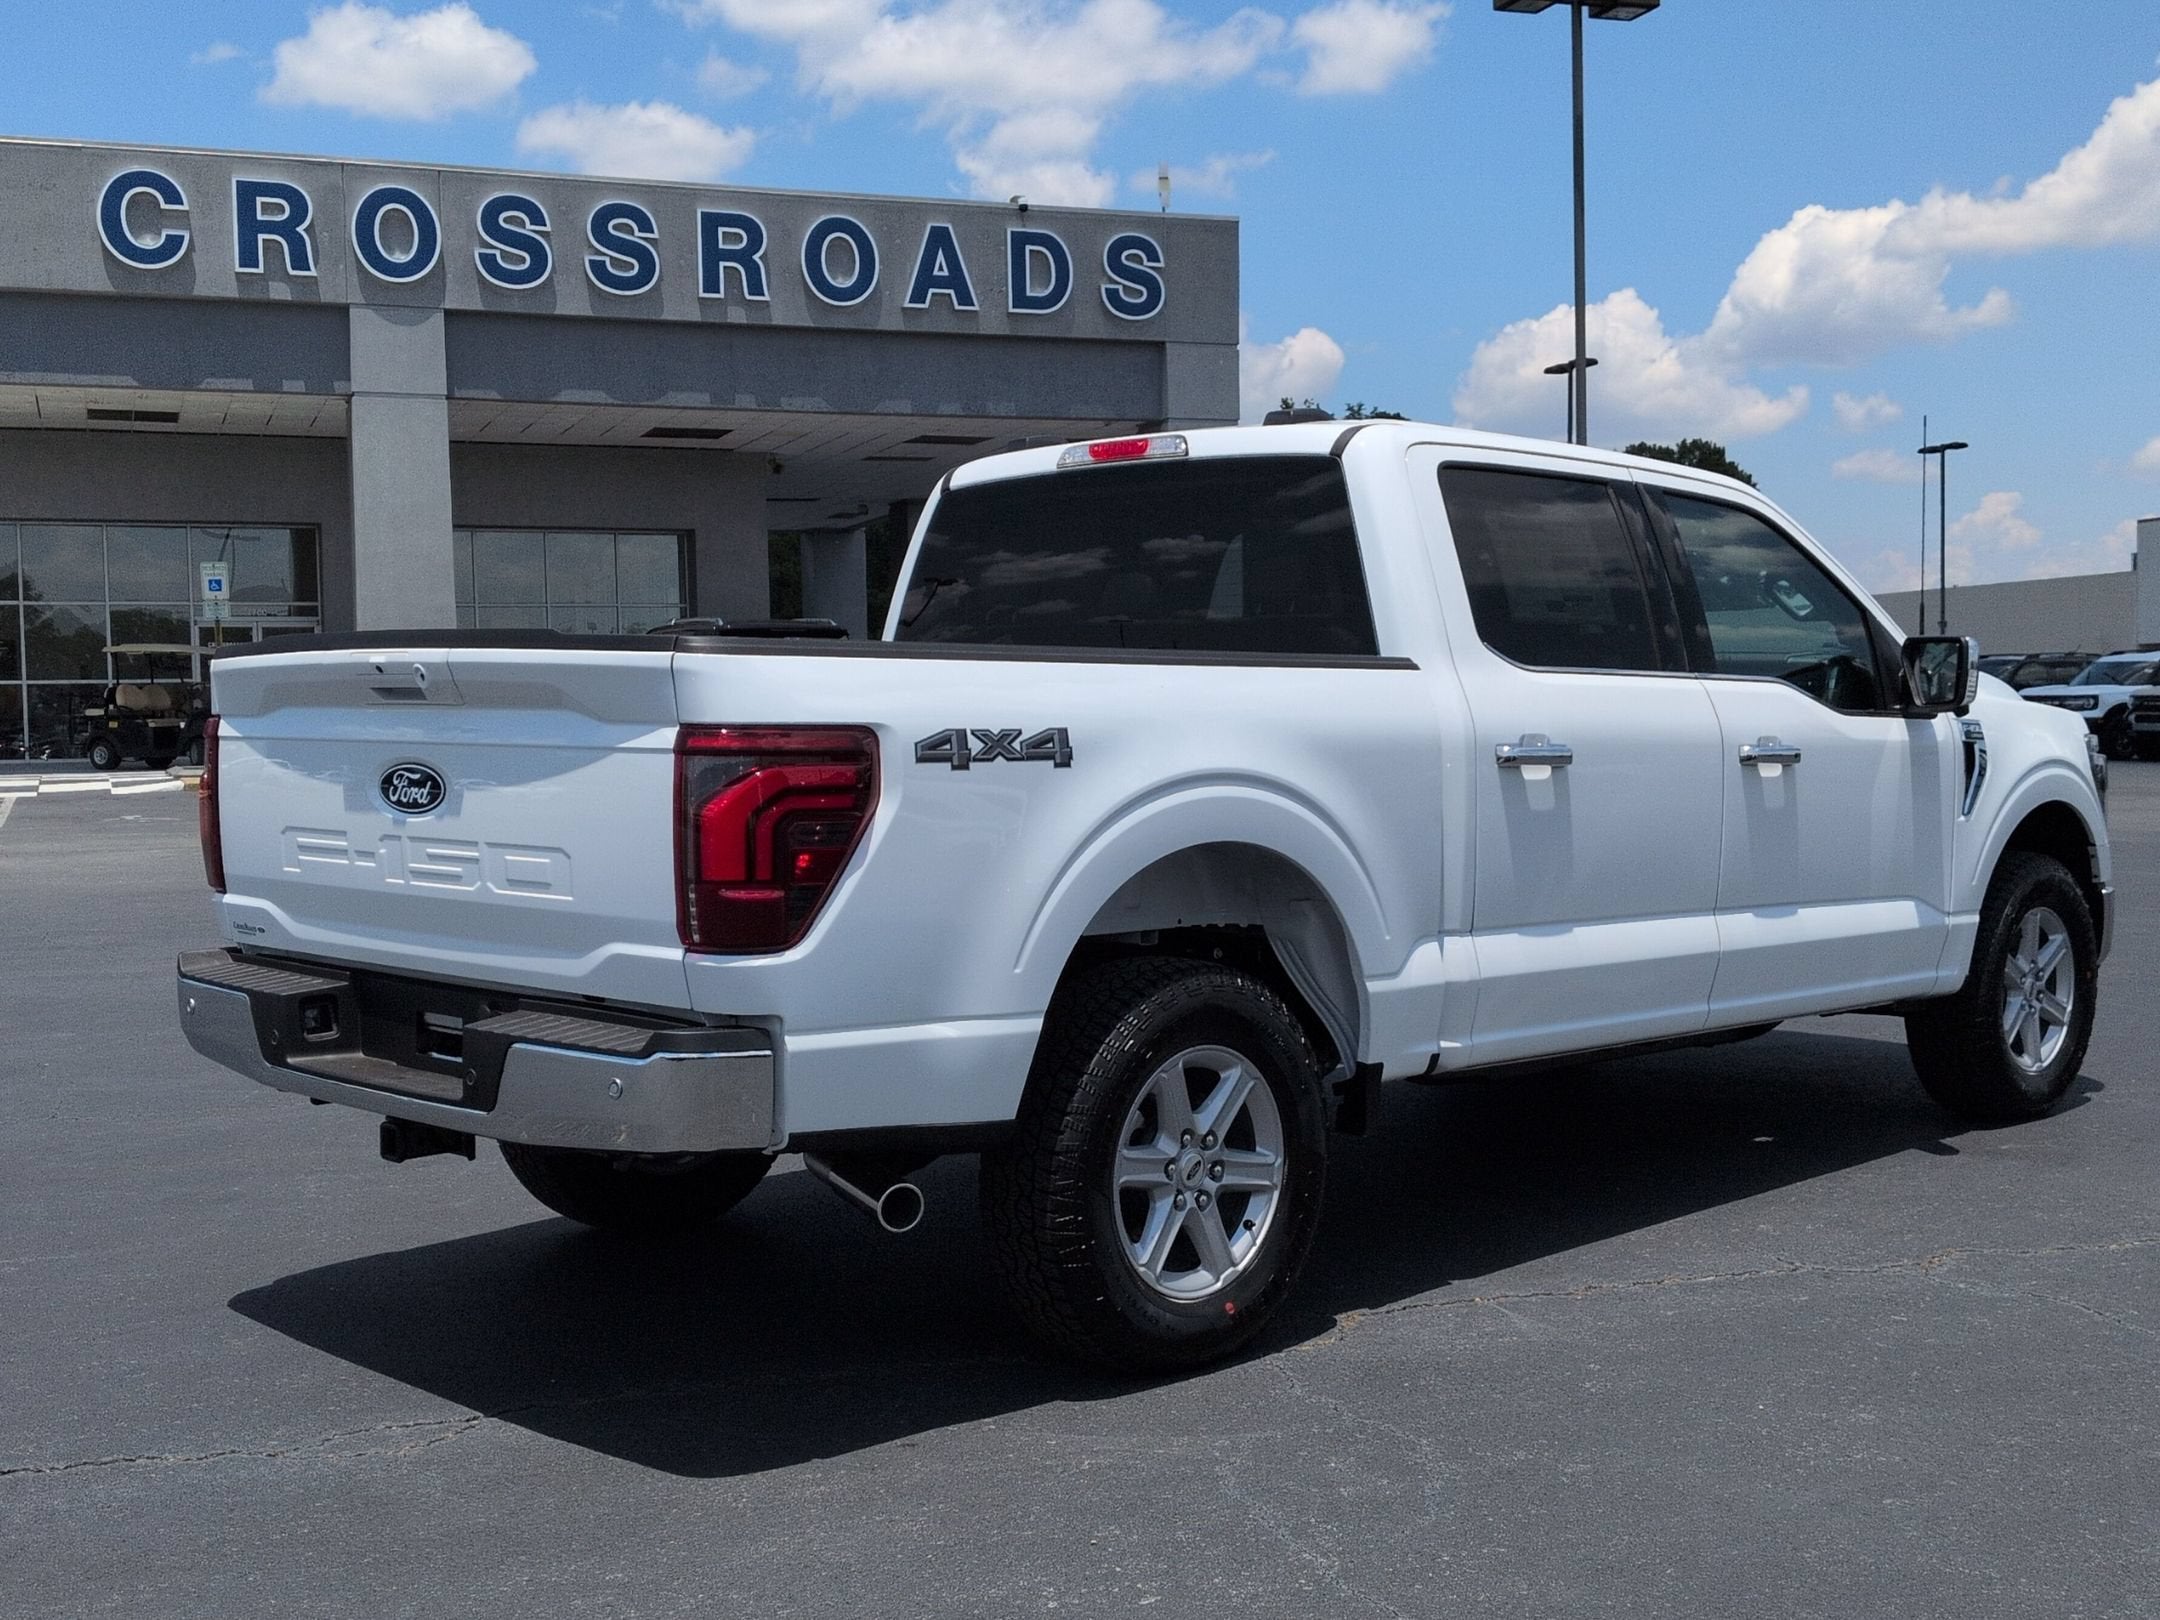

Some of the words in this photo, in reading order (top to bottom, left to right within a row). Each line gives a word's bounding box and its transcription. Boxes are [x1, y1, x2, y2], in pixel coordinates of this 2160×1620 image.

[97, 166, 1166, 321] CROSSROADS
[388, 770, 431, 805] Ford
[281, 825, 574, 901] F-150
